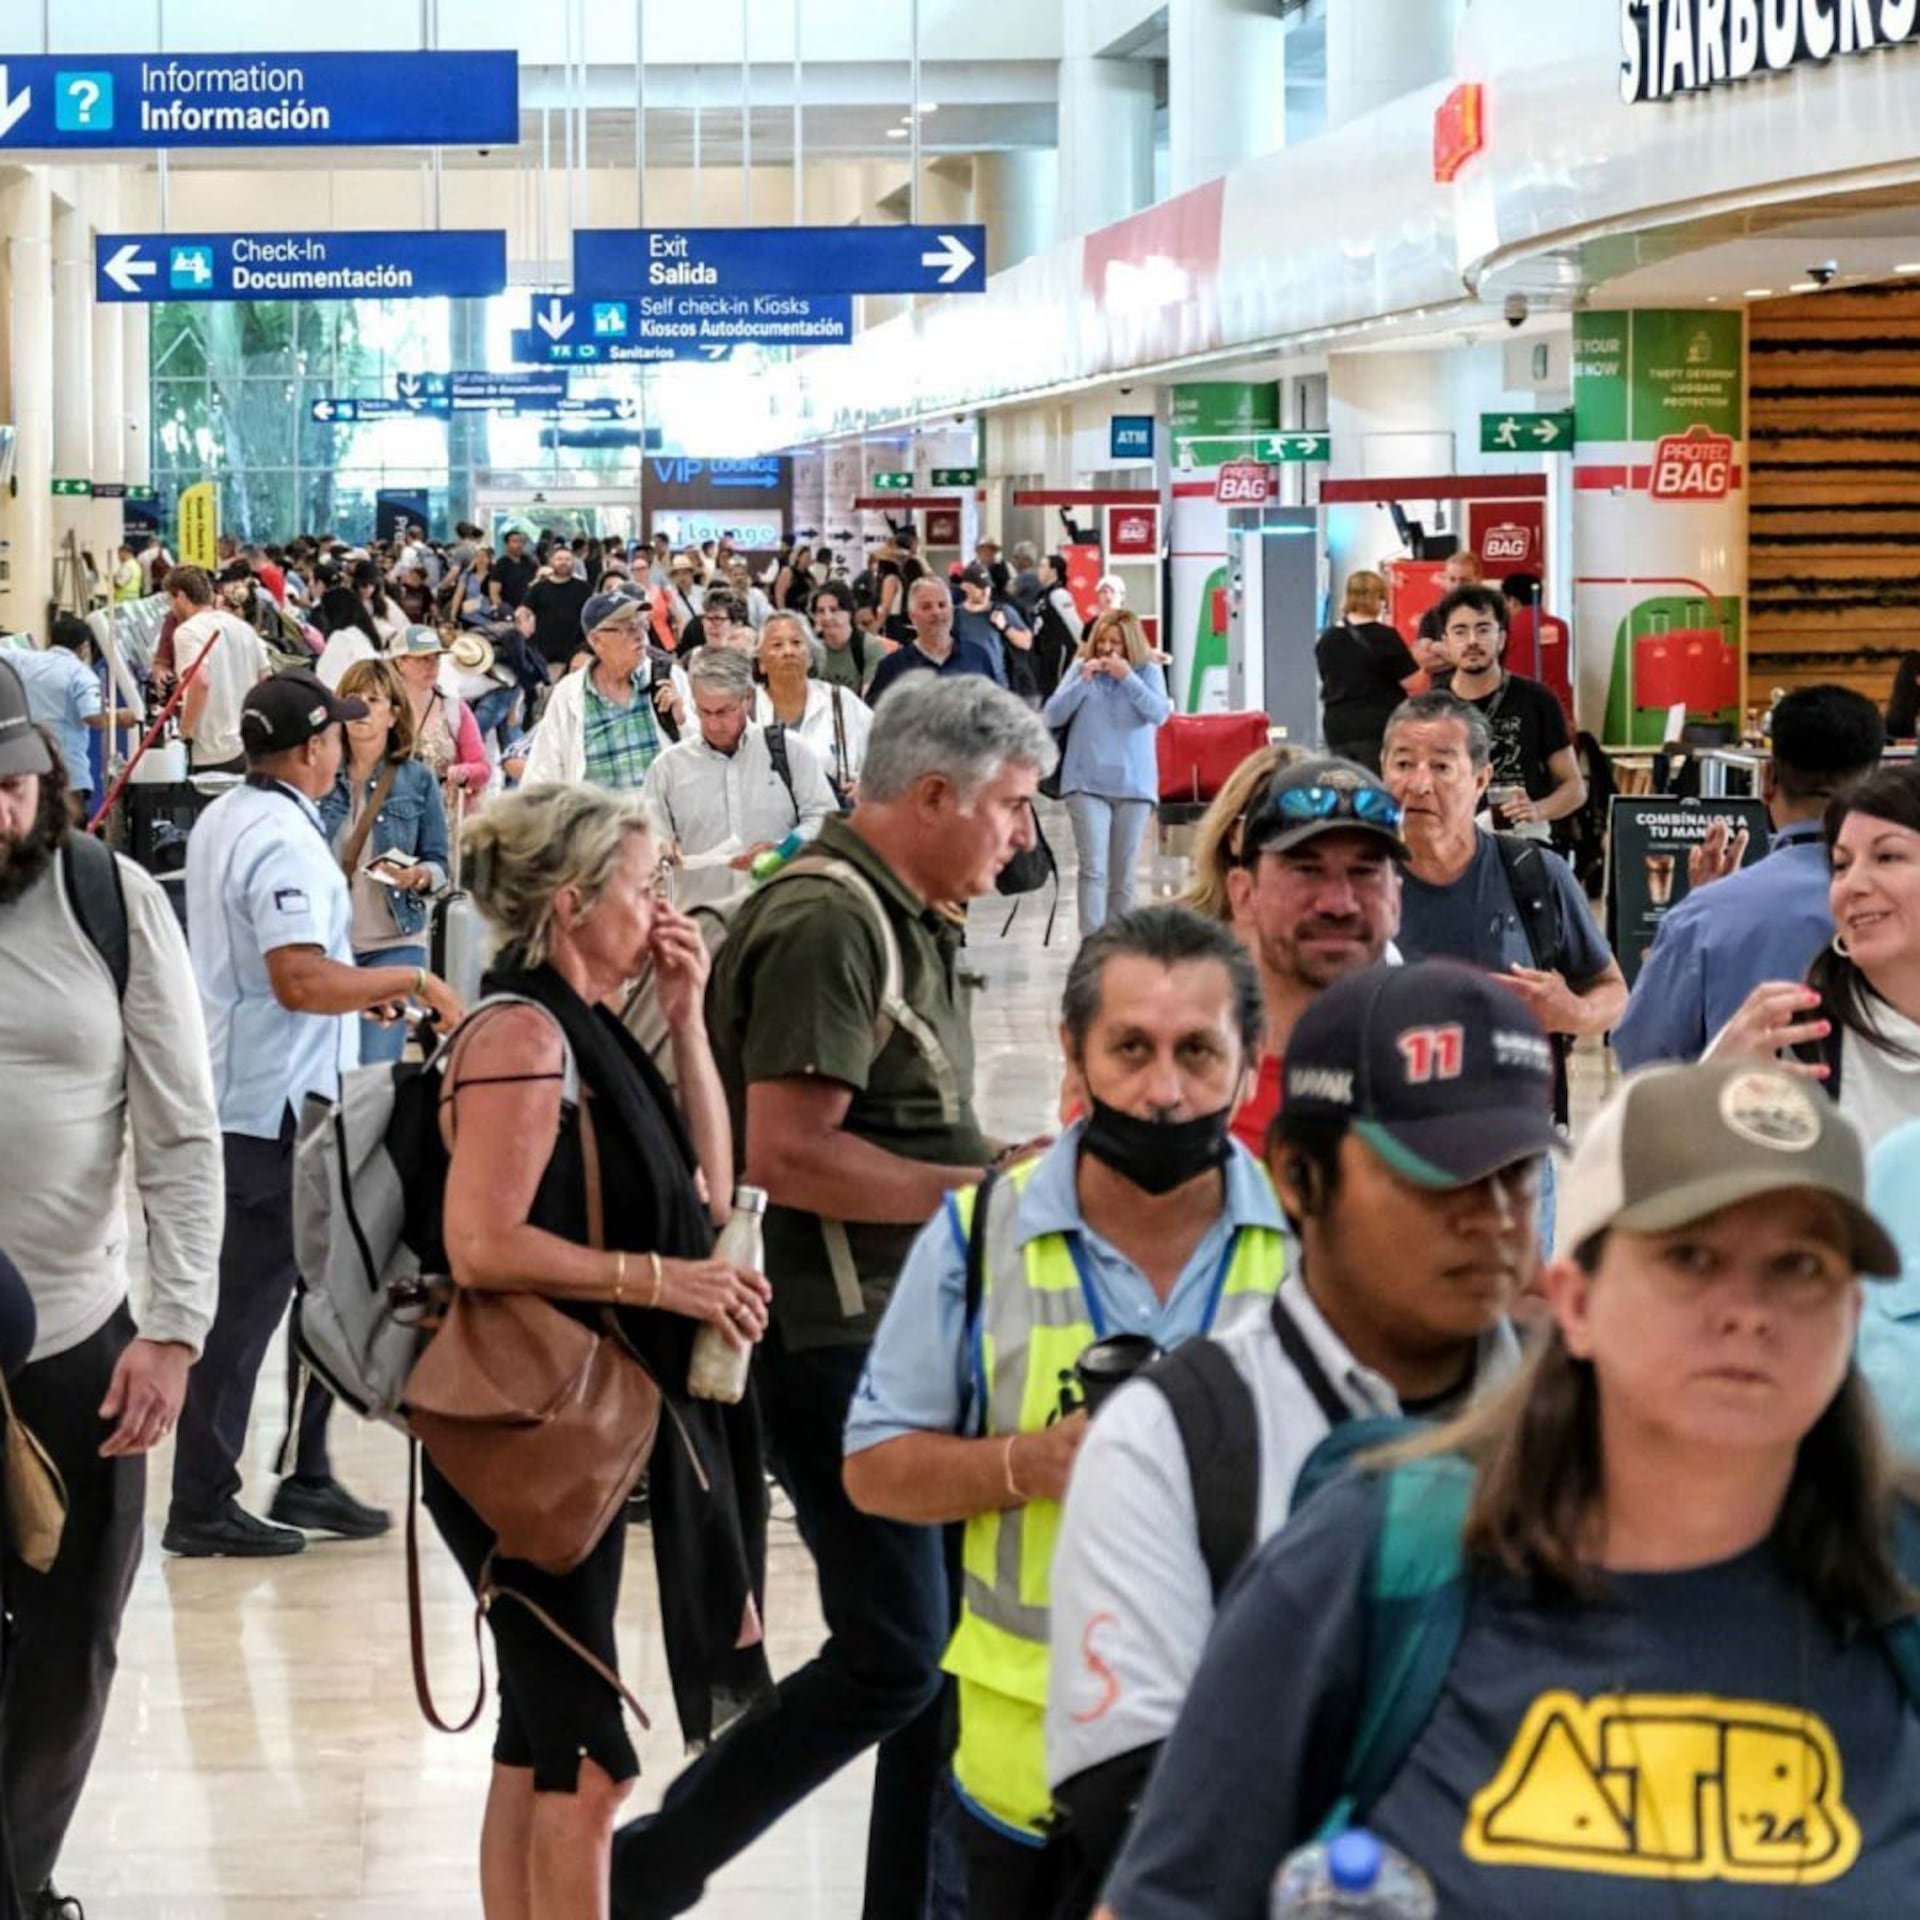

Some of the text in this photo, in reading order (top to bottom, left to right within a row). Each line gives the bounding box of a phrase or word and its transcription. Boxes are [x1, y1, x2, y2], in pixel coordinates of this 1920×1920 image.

[142, 62, 304, 92] Information
[141, 99, 330, 131] Información
[232, 239, 326, 263] Check-In
[649, 234, 688, 258] Exit
[233, 265, 413, 291] Documentación
[649, 262, 717, 286] Salida
[640, 297, 810, 315] Self check-in Kiosks
[640, 318, 844, 337] Kioscos Autodocumentación
[609, 345, 675, 360] Sanitarios
[1117, 430, 1148, 444] ATM
[655, 458, 780, 483] VIP LOUNGE
[1657, 461, 1726, 493] BAG
[1219, 479, 1266, 499] BAG
[1487, 540, 1524, 556] BAG
[1635, 811, 1748, 826] COMBÍNALOS A
[1650, 826, 1668, 838] TU
[1398, 1023, 1463, 1083] 11
[1482, 1709, 1828, 1866] ATB
